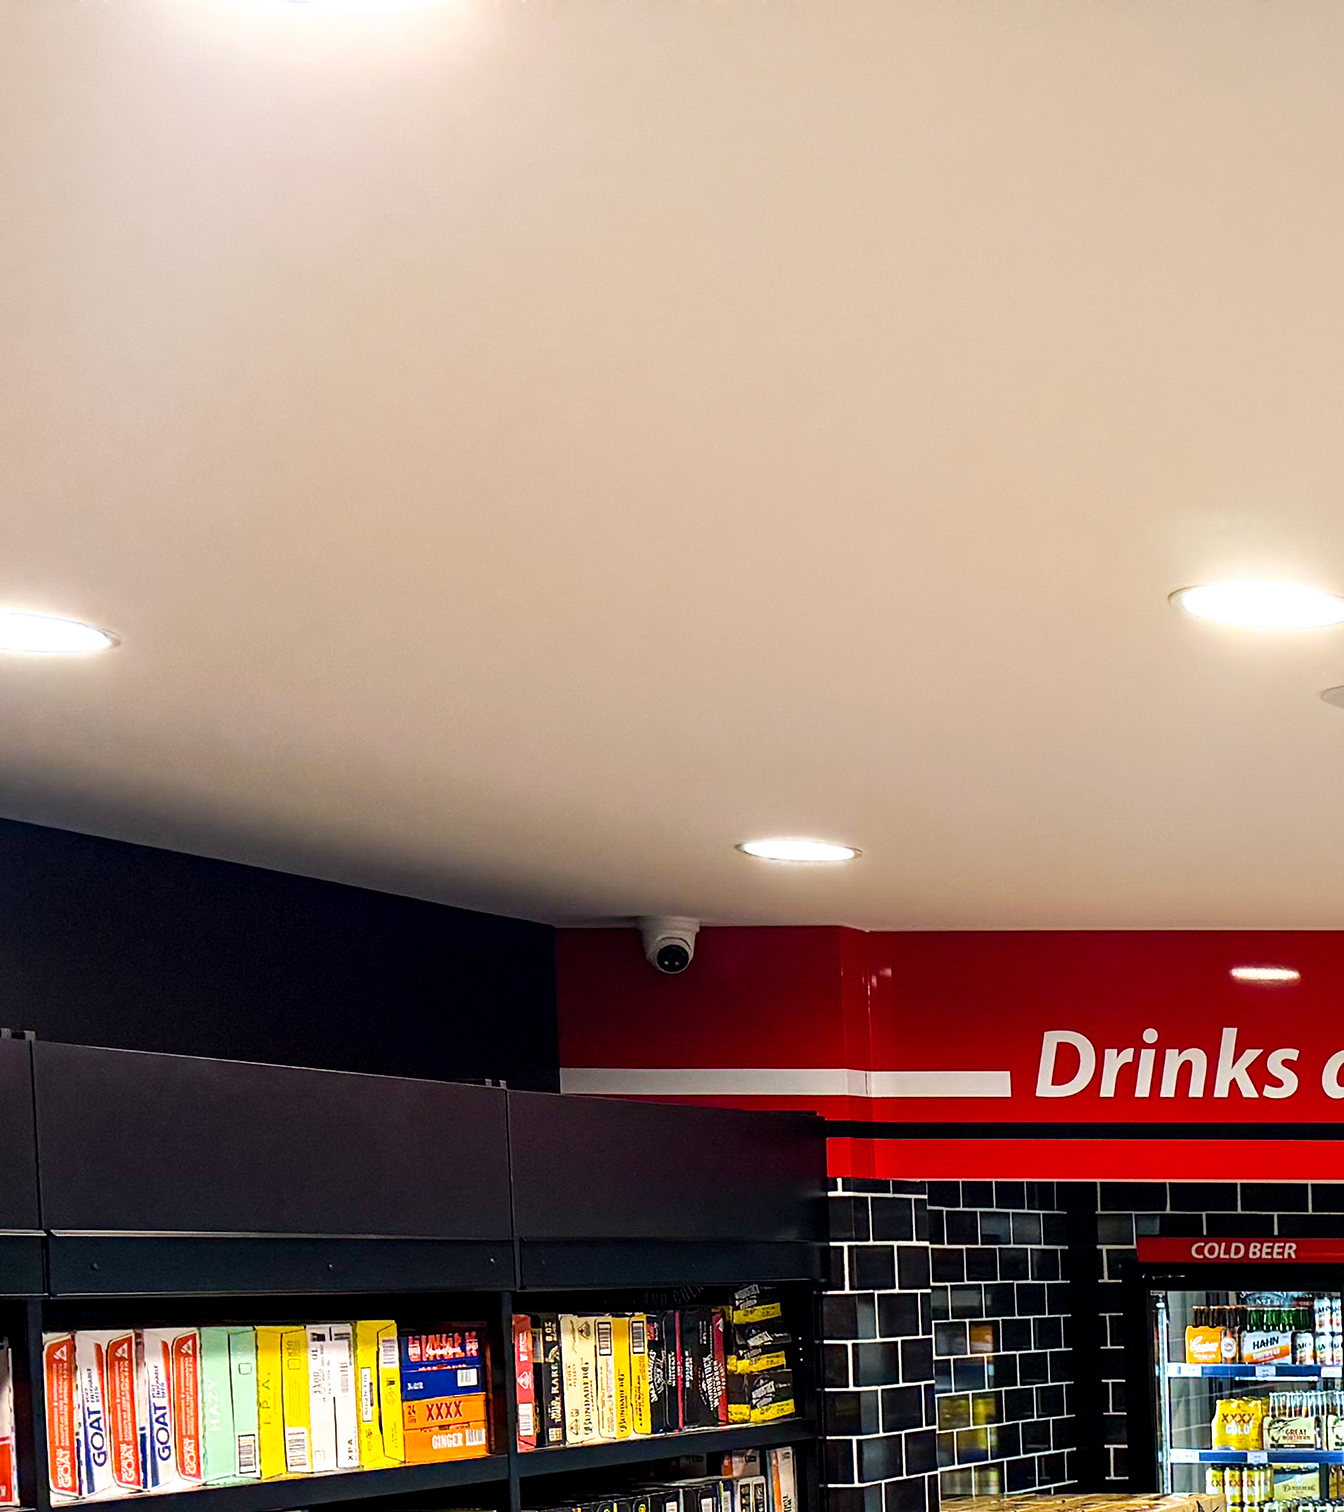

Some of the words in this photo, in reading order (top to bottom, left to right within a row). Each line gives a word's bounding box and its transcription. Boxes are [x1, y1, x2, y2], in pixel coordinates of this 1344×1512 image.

[1035, 1028, 1300, 1099] Drinks
[1191, 1242, 1246, 1259] COLD
[1249, 1242, 1296, 1259] BEER
[1252, 1334, 1279, 1349] HAHN
[426, 1401, 462, 1421] XXXX
[87, 1406, 108, 1467] GOAT
[153, 1402, 171, 1461] GOAT
[432, 1434, 463, 1449] GINGER
